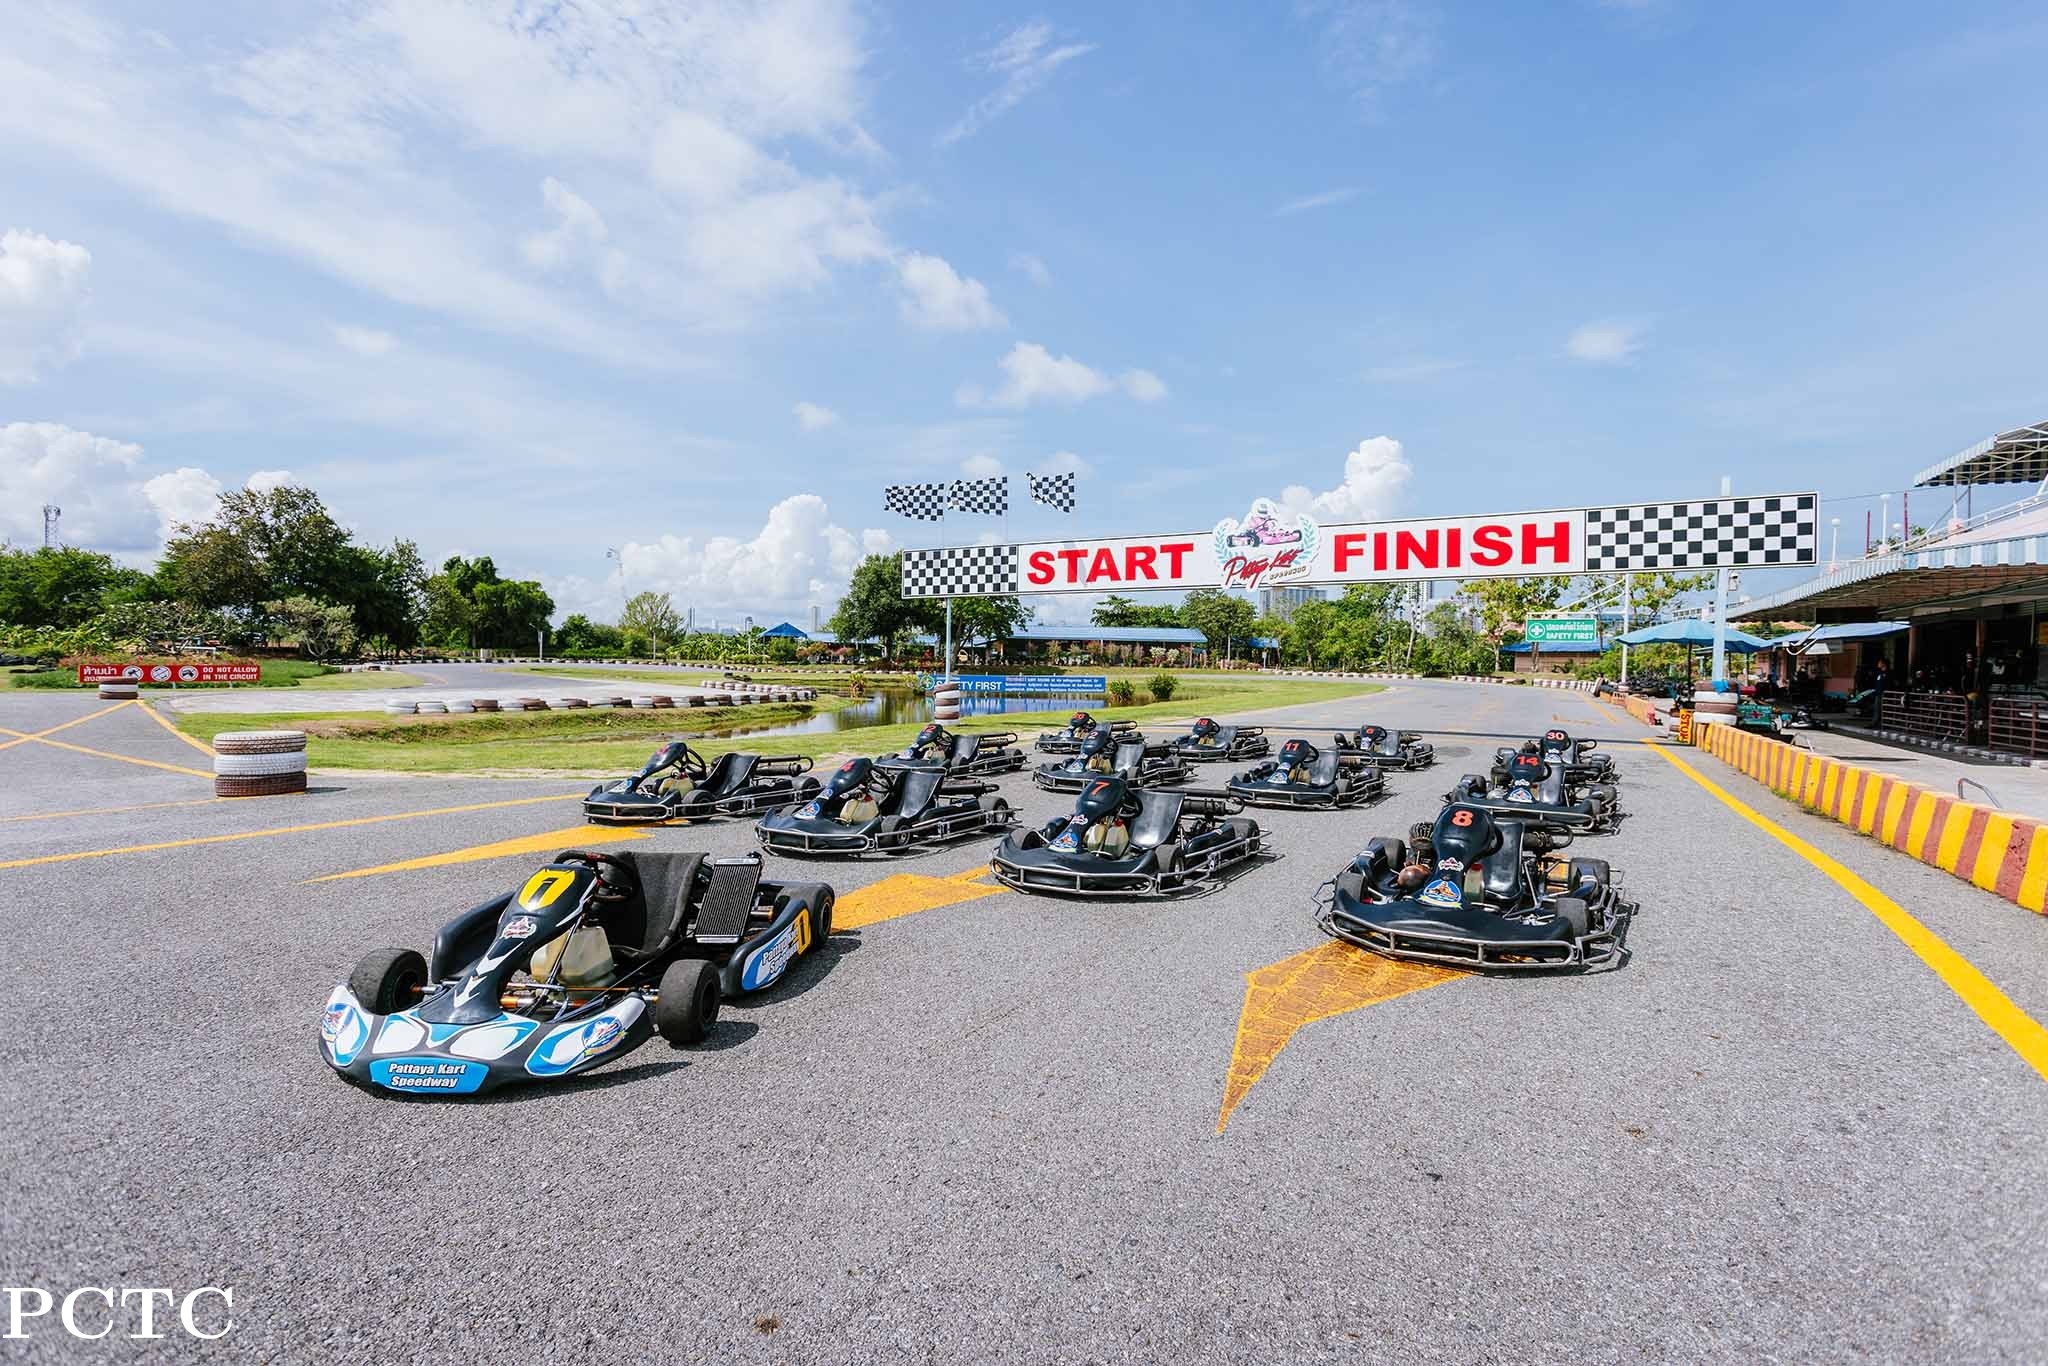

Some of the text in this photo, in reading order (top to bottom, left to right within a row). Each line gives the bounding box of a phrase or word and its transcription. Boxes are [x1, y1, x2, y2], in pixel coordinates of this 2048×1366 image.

[1333, 521, 1570, 573] FINISH
[1028, 543, 1195, 585] START
[975, 681, 1003, 690] FIRST
[1091, 781, 1110, 796] 7
[1452, 810, 1474, 827] 8
[389, 1063, 467, 1075] Pattaya Kart
[391, 1076, 458, 1088] Speedway
